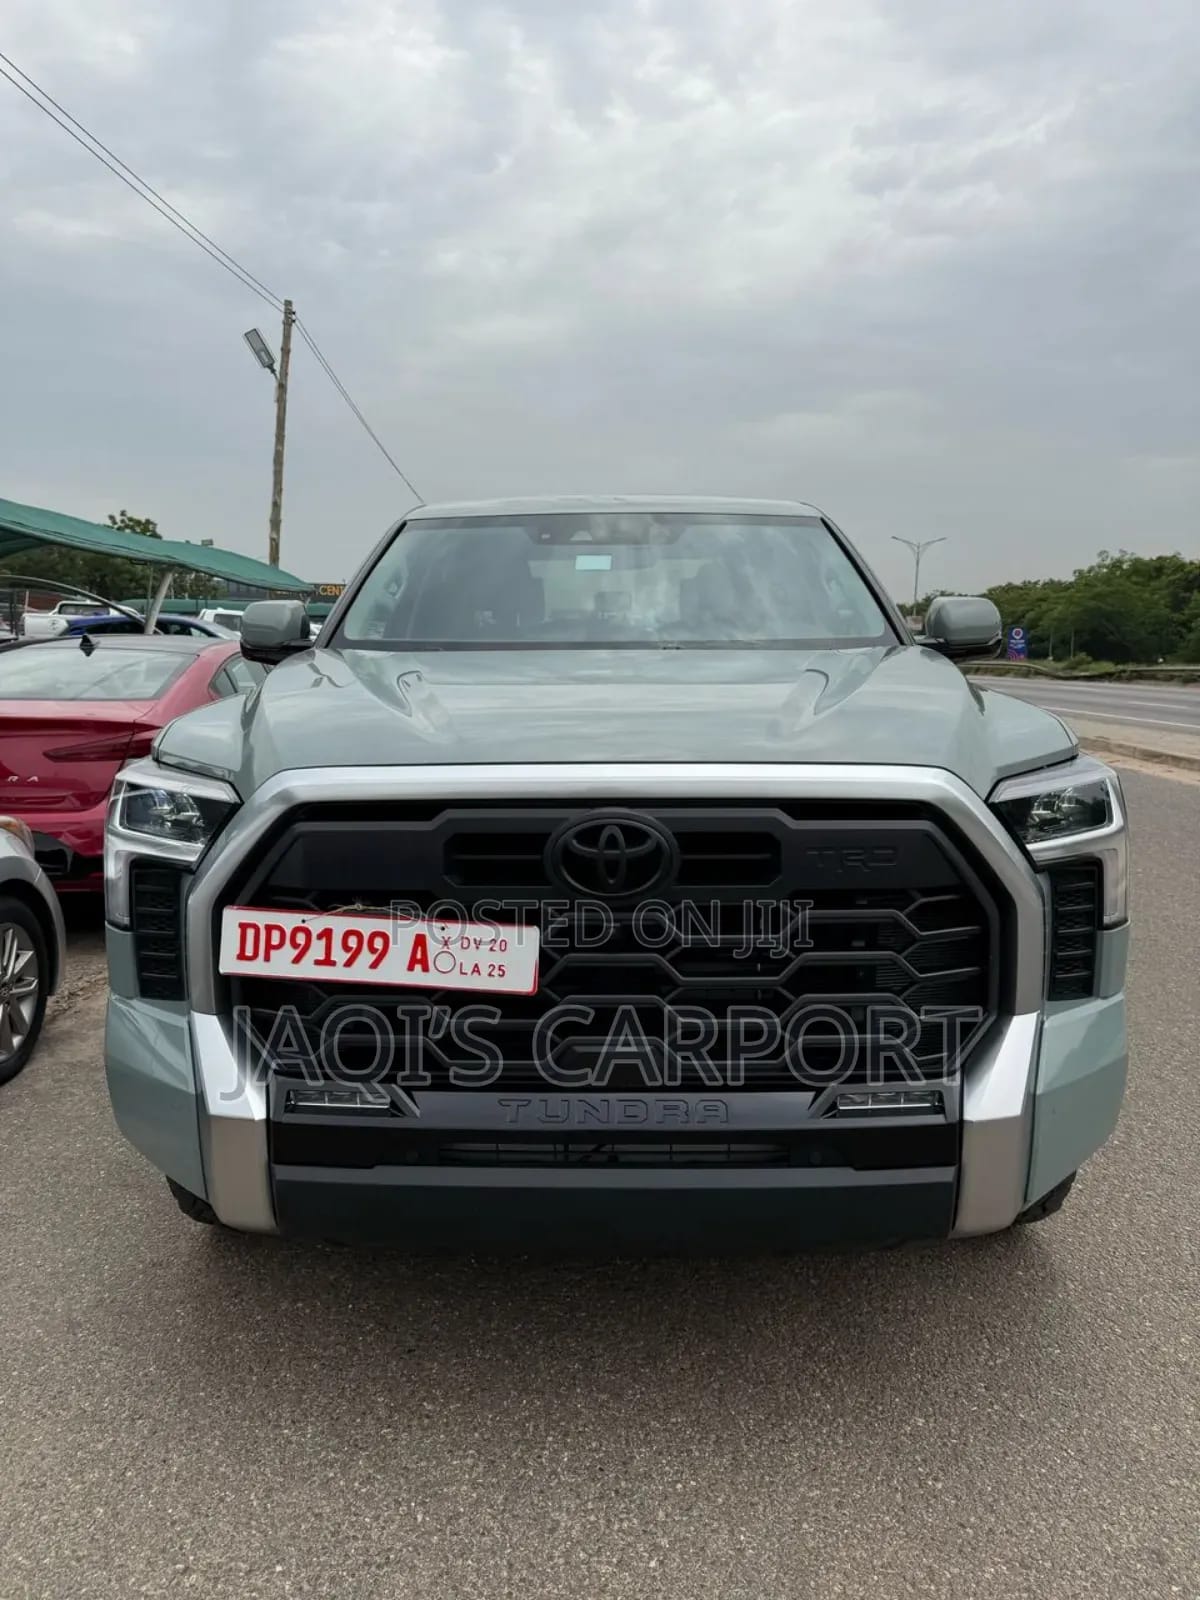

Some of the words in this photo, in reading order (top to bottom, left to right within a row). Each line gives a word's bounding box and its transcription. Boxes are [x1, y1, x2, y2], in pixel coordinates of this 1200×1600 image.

[805, 846, 898, 871] TRD
[236, 921, 391, 970] DP9199
[406, 933, 430, 973] A
[460, 935, 482, 951] DV
[488, 938, 508, 952] 20
[459, 962, 482, 977] LA
[488, 963, 507, 978] 25
[497, 1098, 728, 1124] TUNDRA
